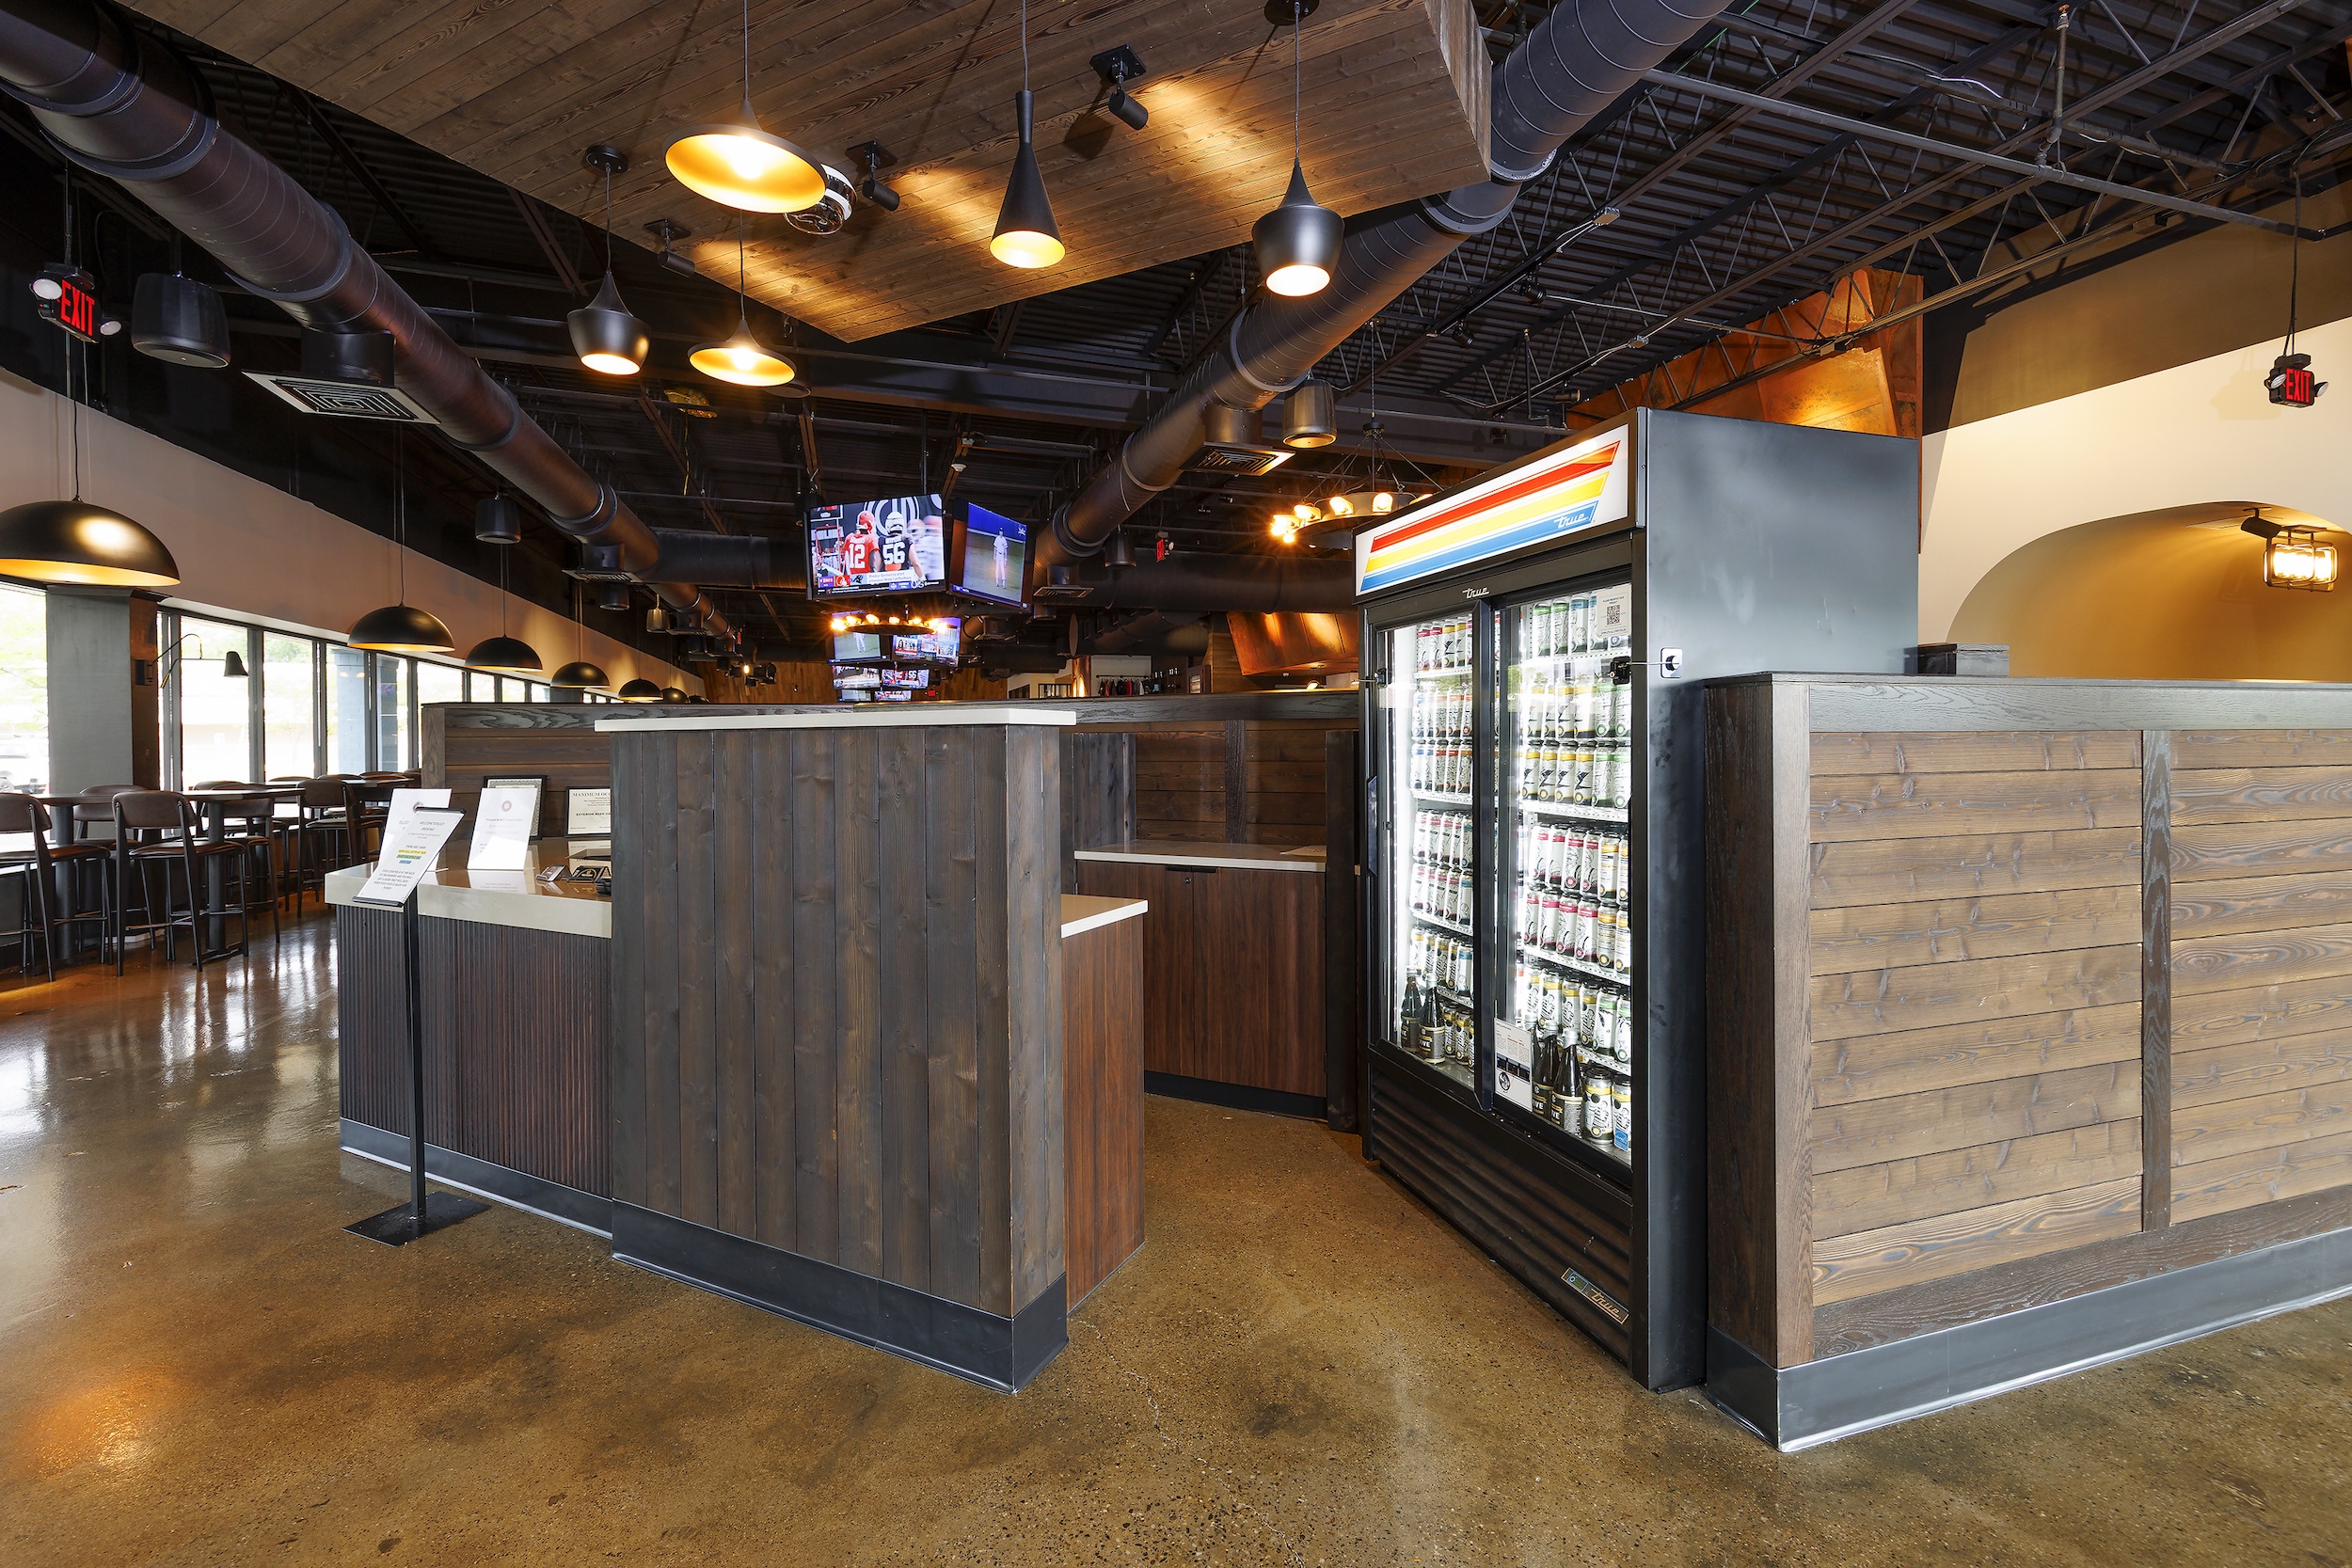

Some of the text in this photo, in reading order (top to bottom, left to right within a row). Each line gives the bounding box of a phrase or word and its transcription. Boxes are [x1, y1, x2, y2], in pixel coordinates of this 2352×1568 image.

[61, 279, 95, 336] EXIT
[2286, 368, 2311, 403] EXIT
[849, 543, 865, 568] 12
[882, 541, 905, 565] 56
[908, 670, 917, 679] 56
